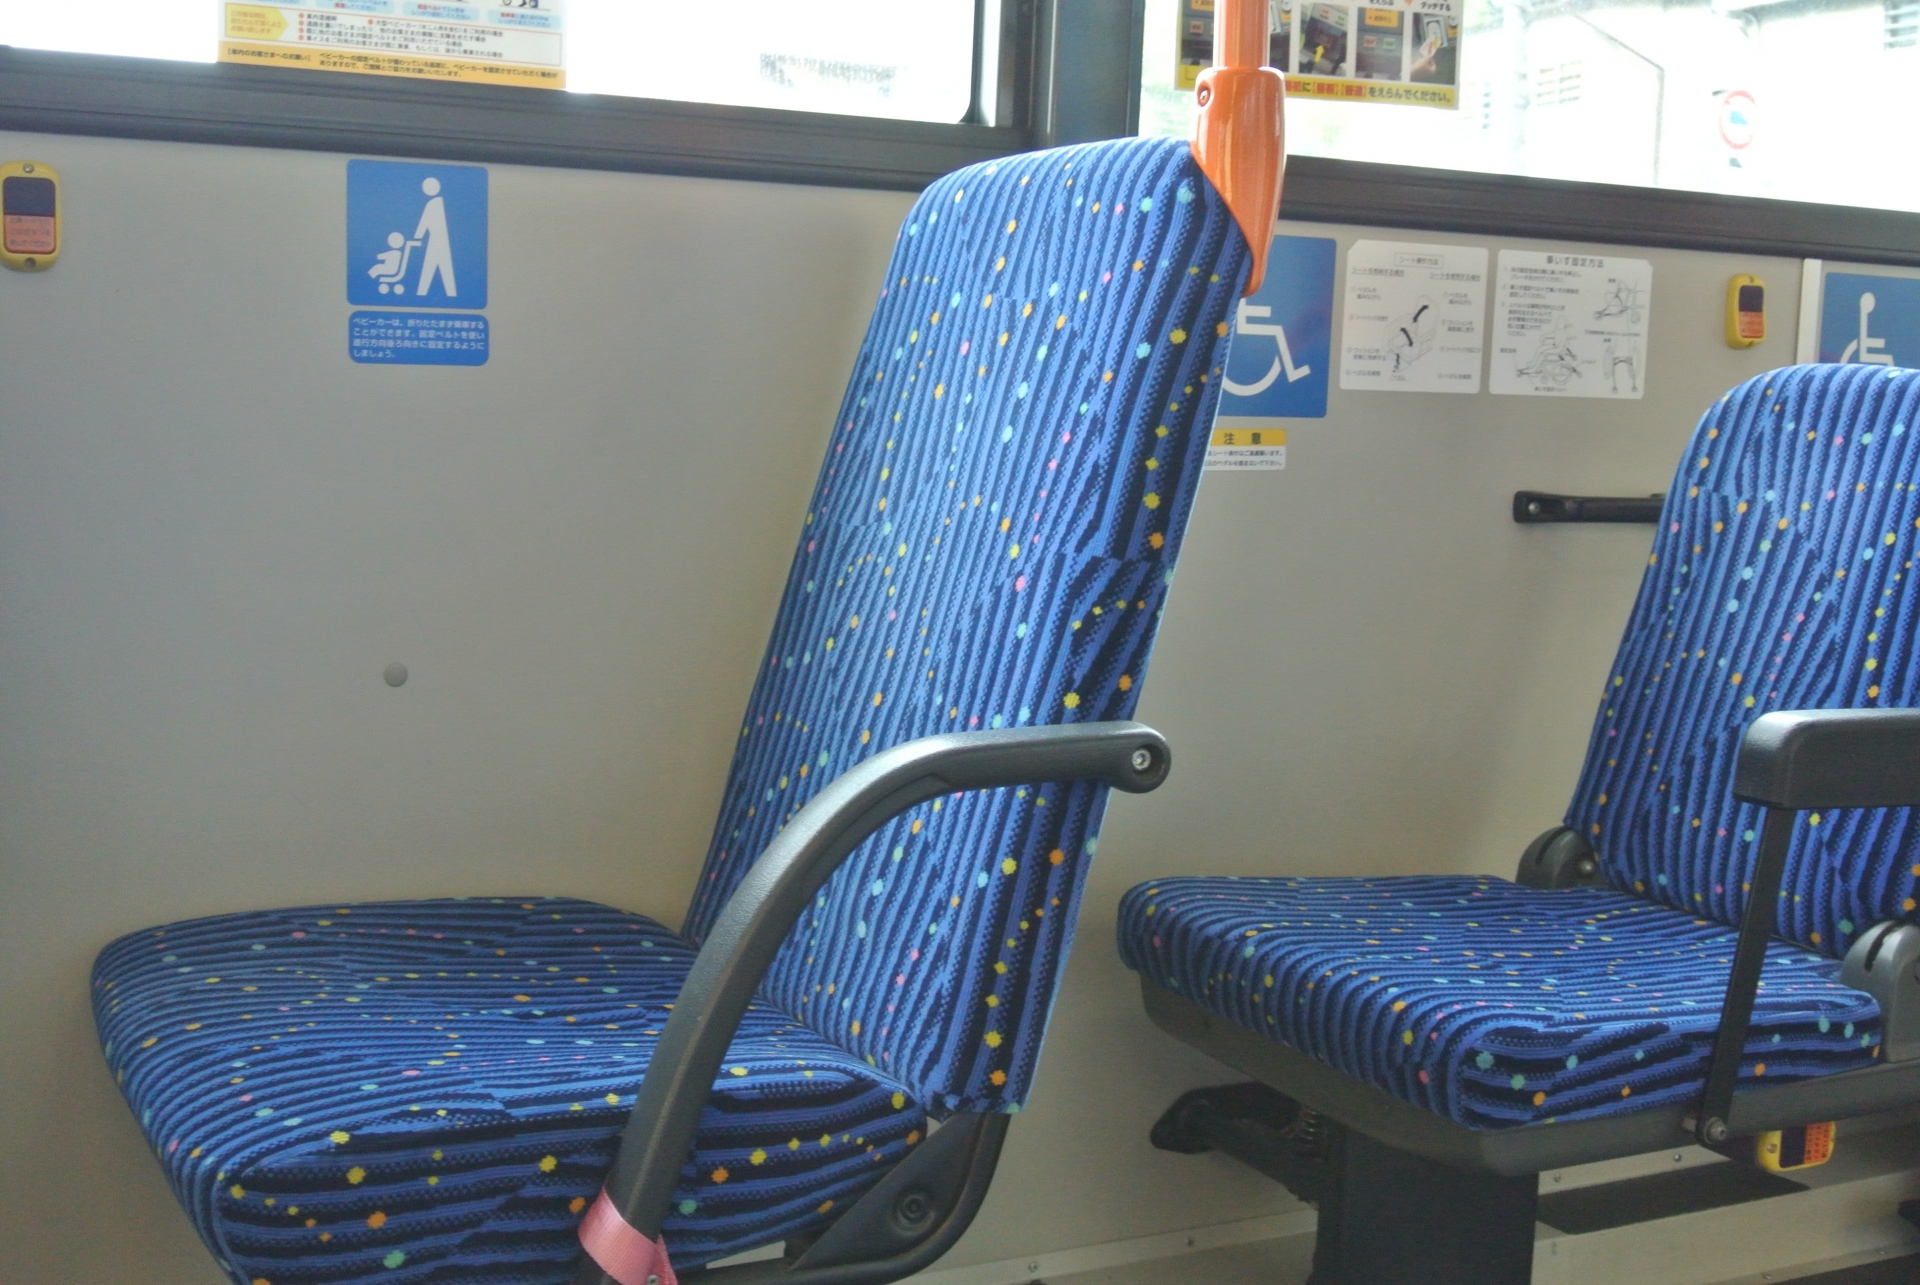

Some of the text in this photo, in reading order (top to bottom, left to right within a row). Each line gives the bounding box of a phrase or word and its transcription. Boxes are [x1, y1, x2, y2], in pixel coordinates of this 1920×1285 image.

[353, 349, 397, 358] しましょう。
